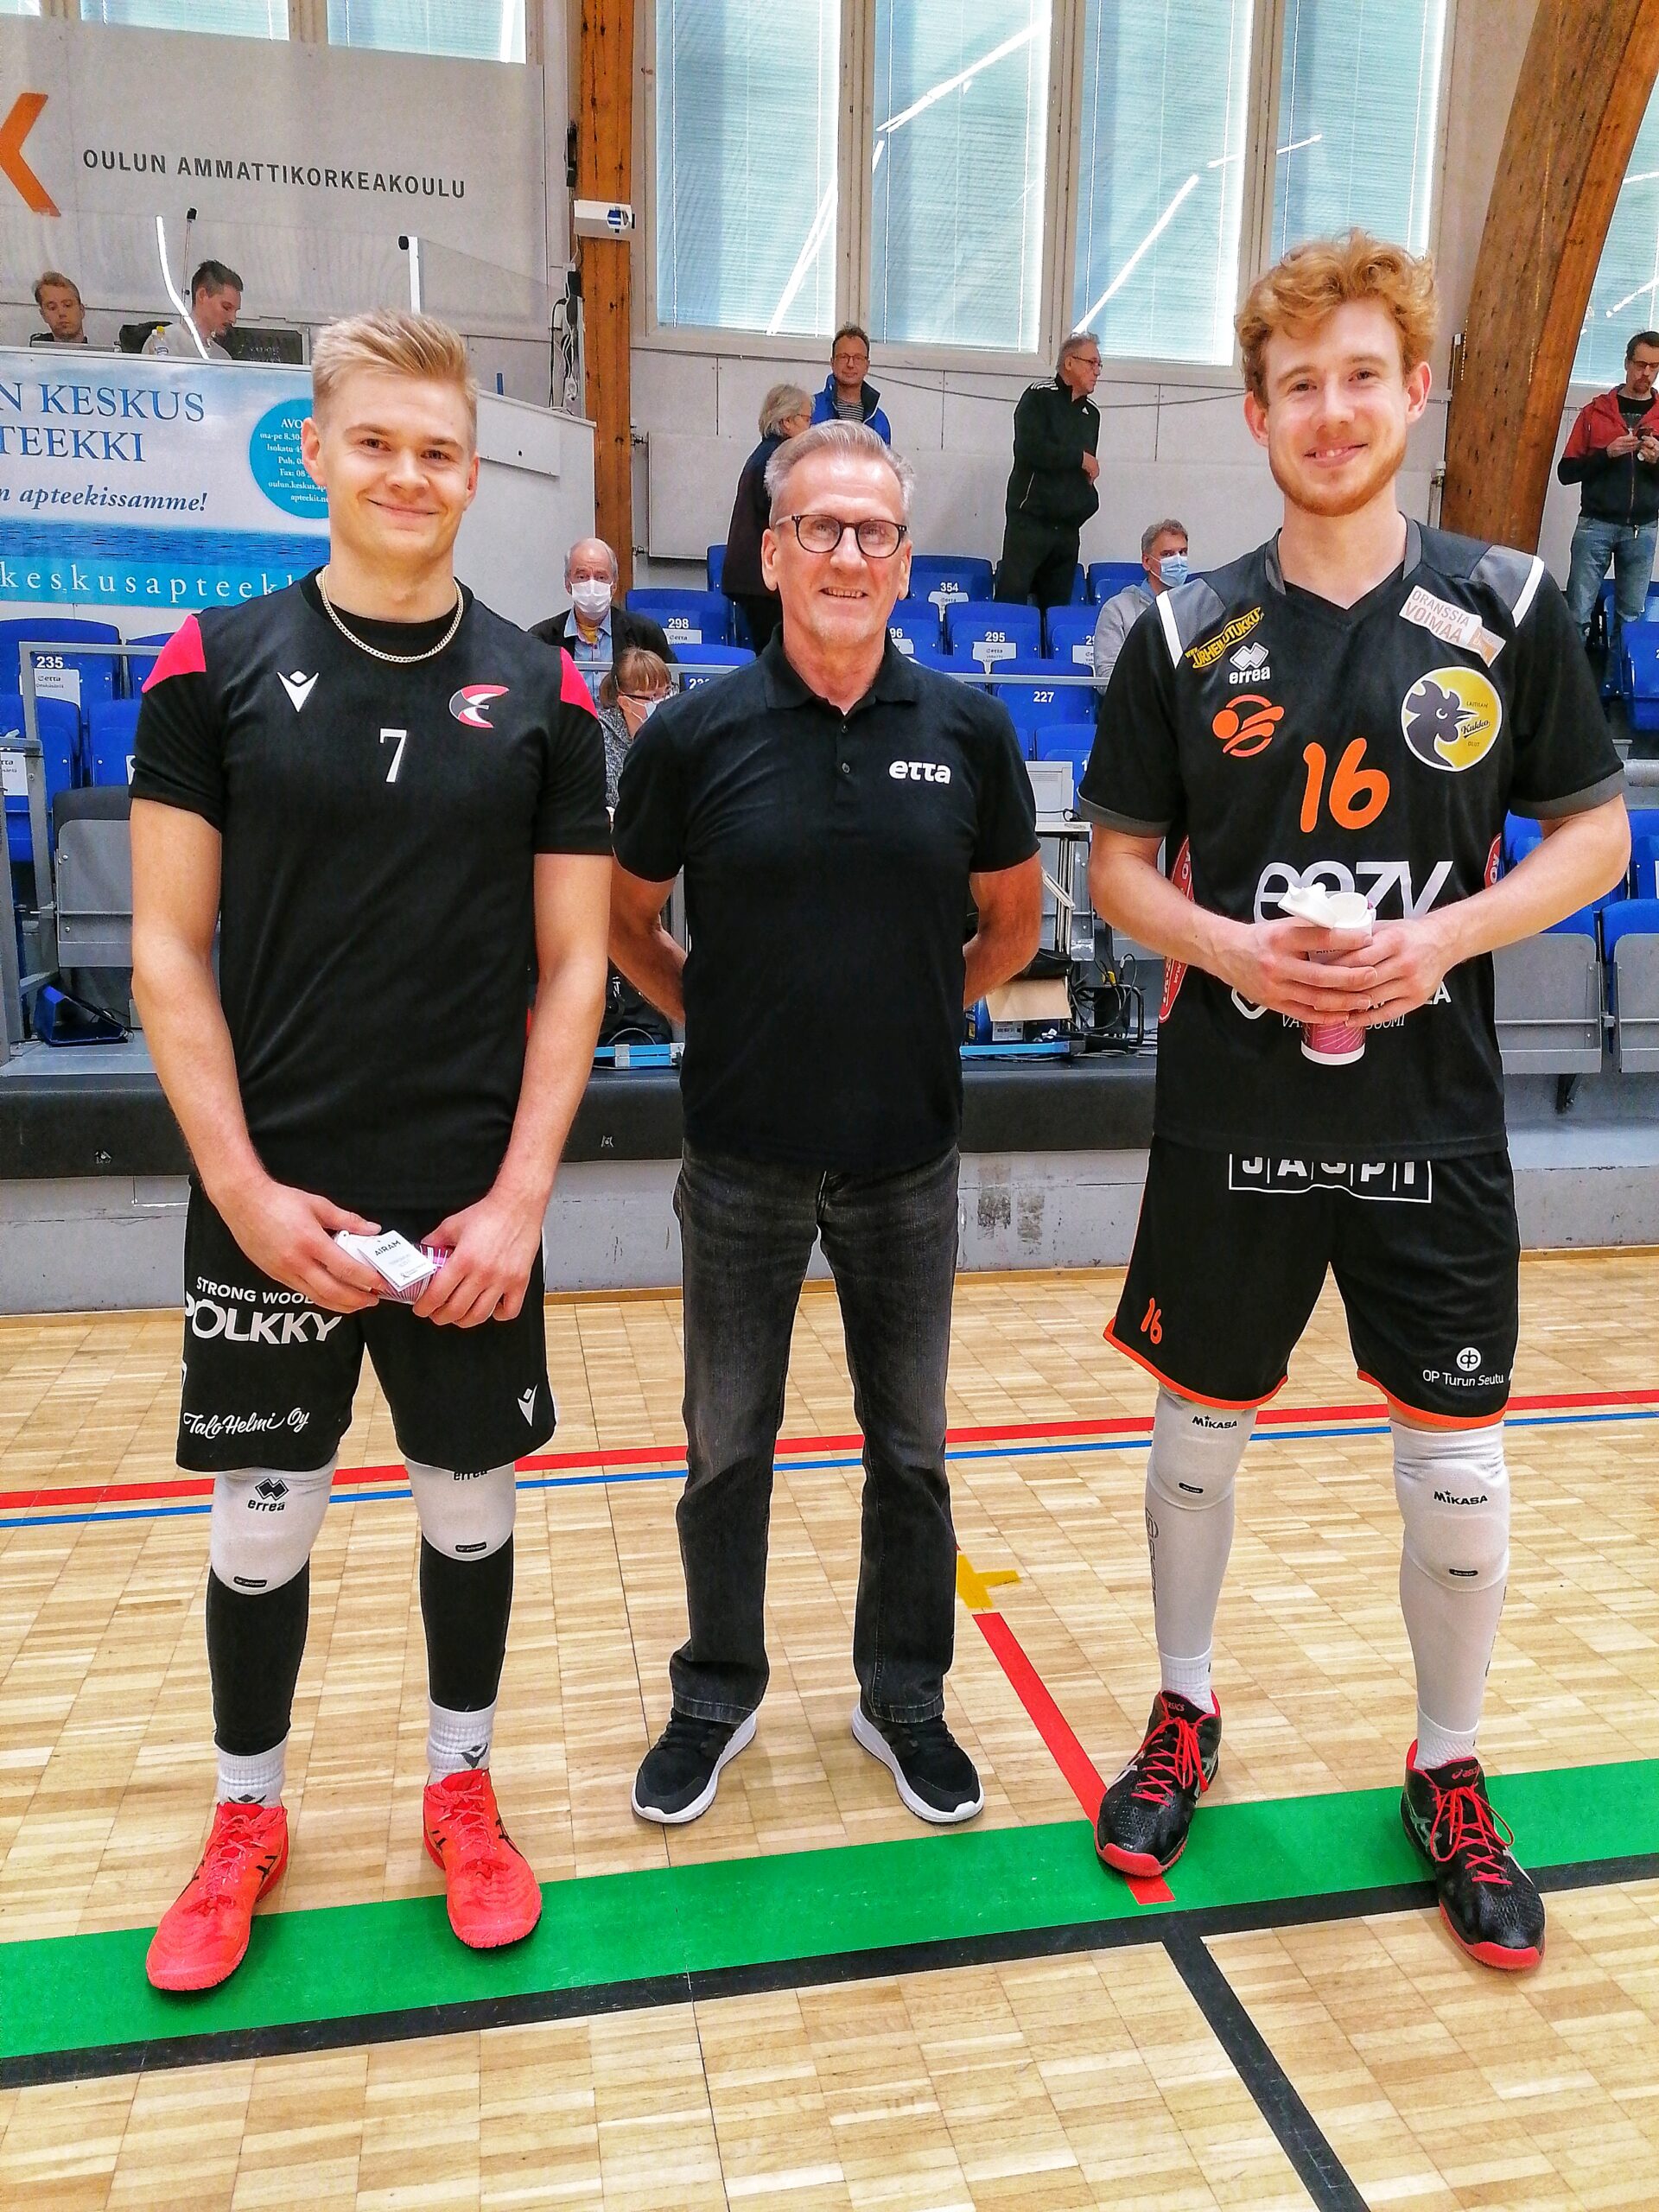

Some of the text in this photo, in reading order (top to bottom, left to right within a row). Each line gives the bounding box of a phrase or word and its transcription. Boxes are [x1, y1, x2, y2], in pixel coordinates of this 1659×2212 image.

[83, 149, 465, 199] OULUN AMMATTIKORKEAKOULU
[38, 383, 205, 422] KESKUS
[0, 425, 146, 462] TEEKKI
[19, 485, 208, 512] apteekissamme!
[940, 582, 959, 593] 354
[668, 618, 690, 629] 298
[889, 628, 904, 639] 96
[1405, 601, 1464, 643] VOIMAA
[985, 632, 1006, 643] 295
[36, 656, 64, 669] 235
[1033, 690, 1054, 703] 227
[1460, 720, 1489, 734] Kukko
[379, 728, 408, 783] 7
[888, 760, 951, 785] etta
[1300, 737, 1390, 833] 16
[375, 1240, 401, 1255] AIRAM
[196, 1276, 257, 1302] STRONG
[1141, 1297, 1163, 1344] 16
[1422, 1370, 1504, 1387] OP Turun Seutu
[287, 1407, 310, 1433] Oy
